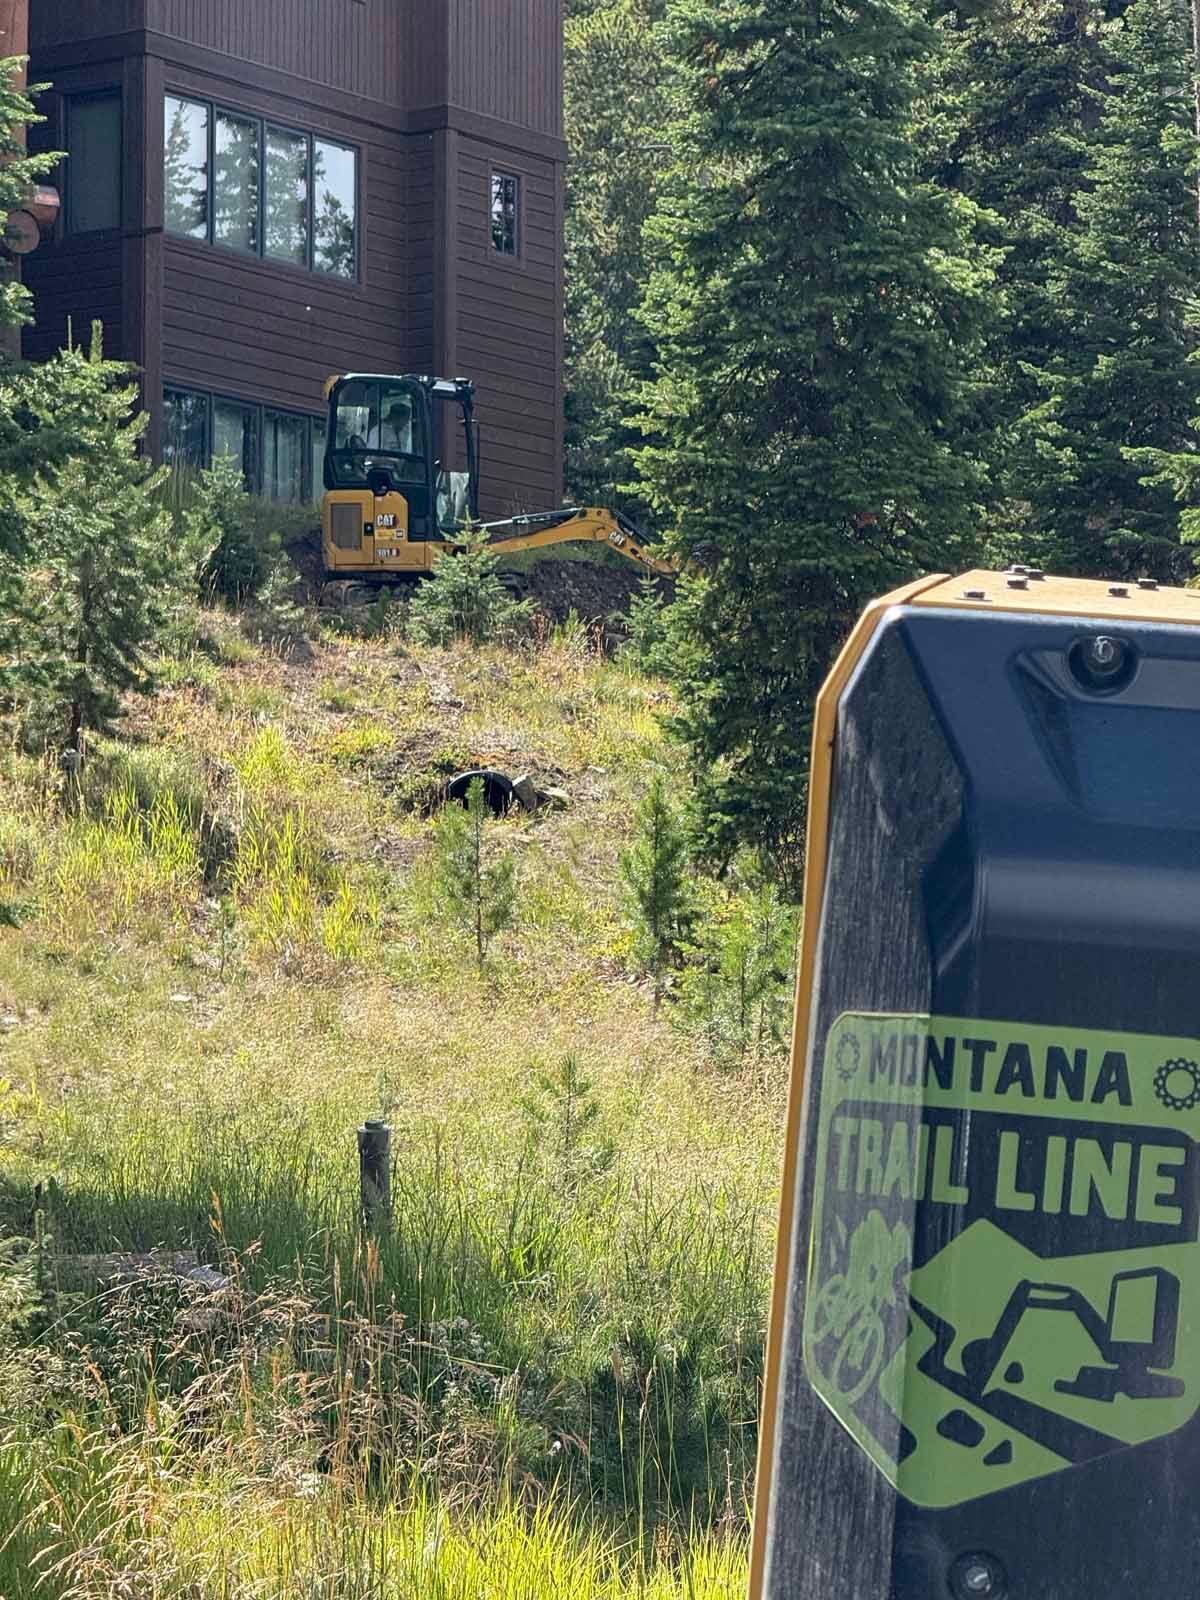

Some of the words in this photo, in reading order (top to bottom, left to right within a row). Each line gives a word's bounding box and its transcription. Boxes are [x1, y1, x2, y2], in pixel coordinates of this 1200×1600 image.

[377, 513, 395, 527] CAT
[608, 530, 625, 546] CAT
[868, 1033, 1133, 1106] MONTANA
[833, 1115, 969, 1205] TRAIL
[995, 1129, 1186, 1226] LINE
